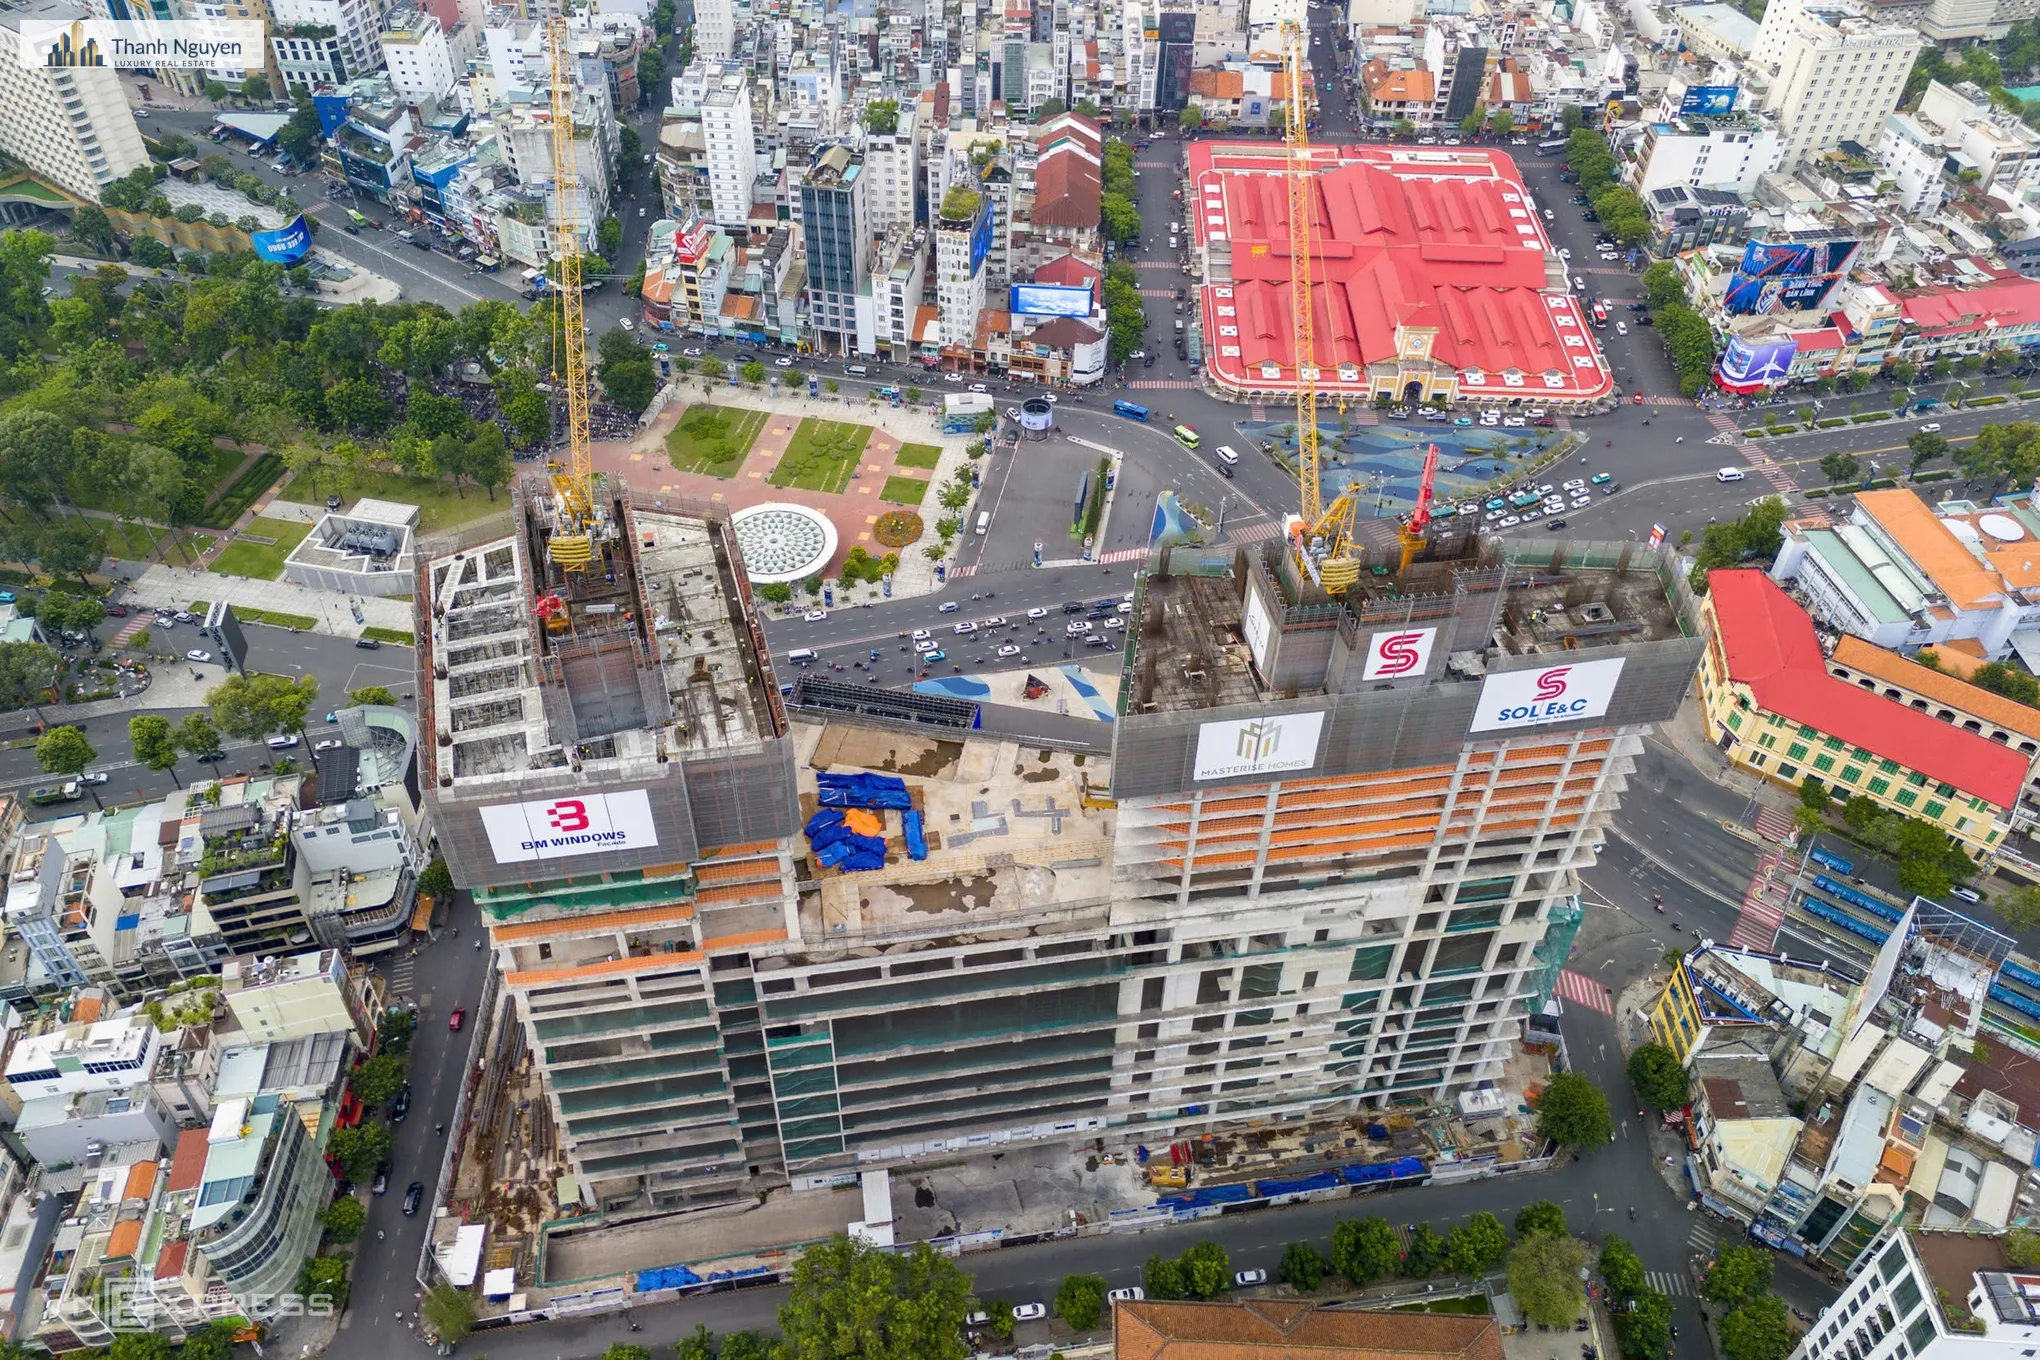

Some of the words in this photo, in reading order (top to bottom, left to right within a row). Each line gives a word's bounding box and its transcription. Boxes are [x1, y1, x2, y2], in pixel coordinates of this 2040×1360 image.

[1498, 705, 1539, 722] SOL
[1201, 763, 1264, 777] MASTERISE
[1267, 759, 1307, 770] HOMES
[521, 840, 549, 850] BM
[551, 831, 626, 847] WINDOWS
